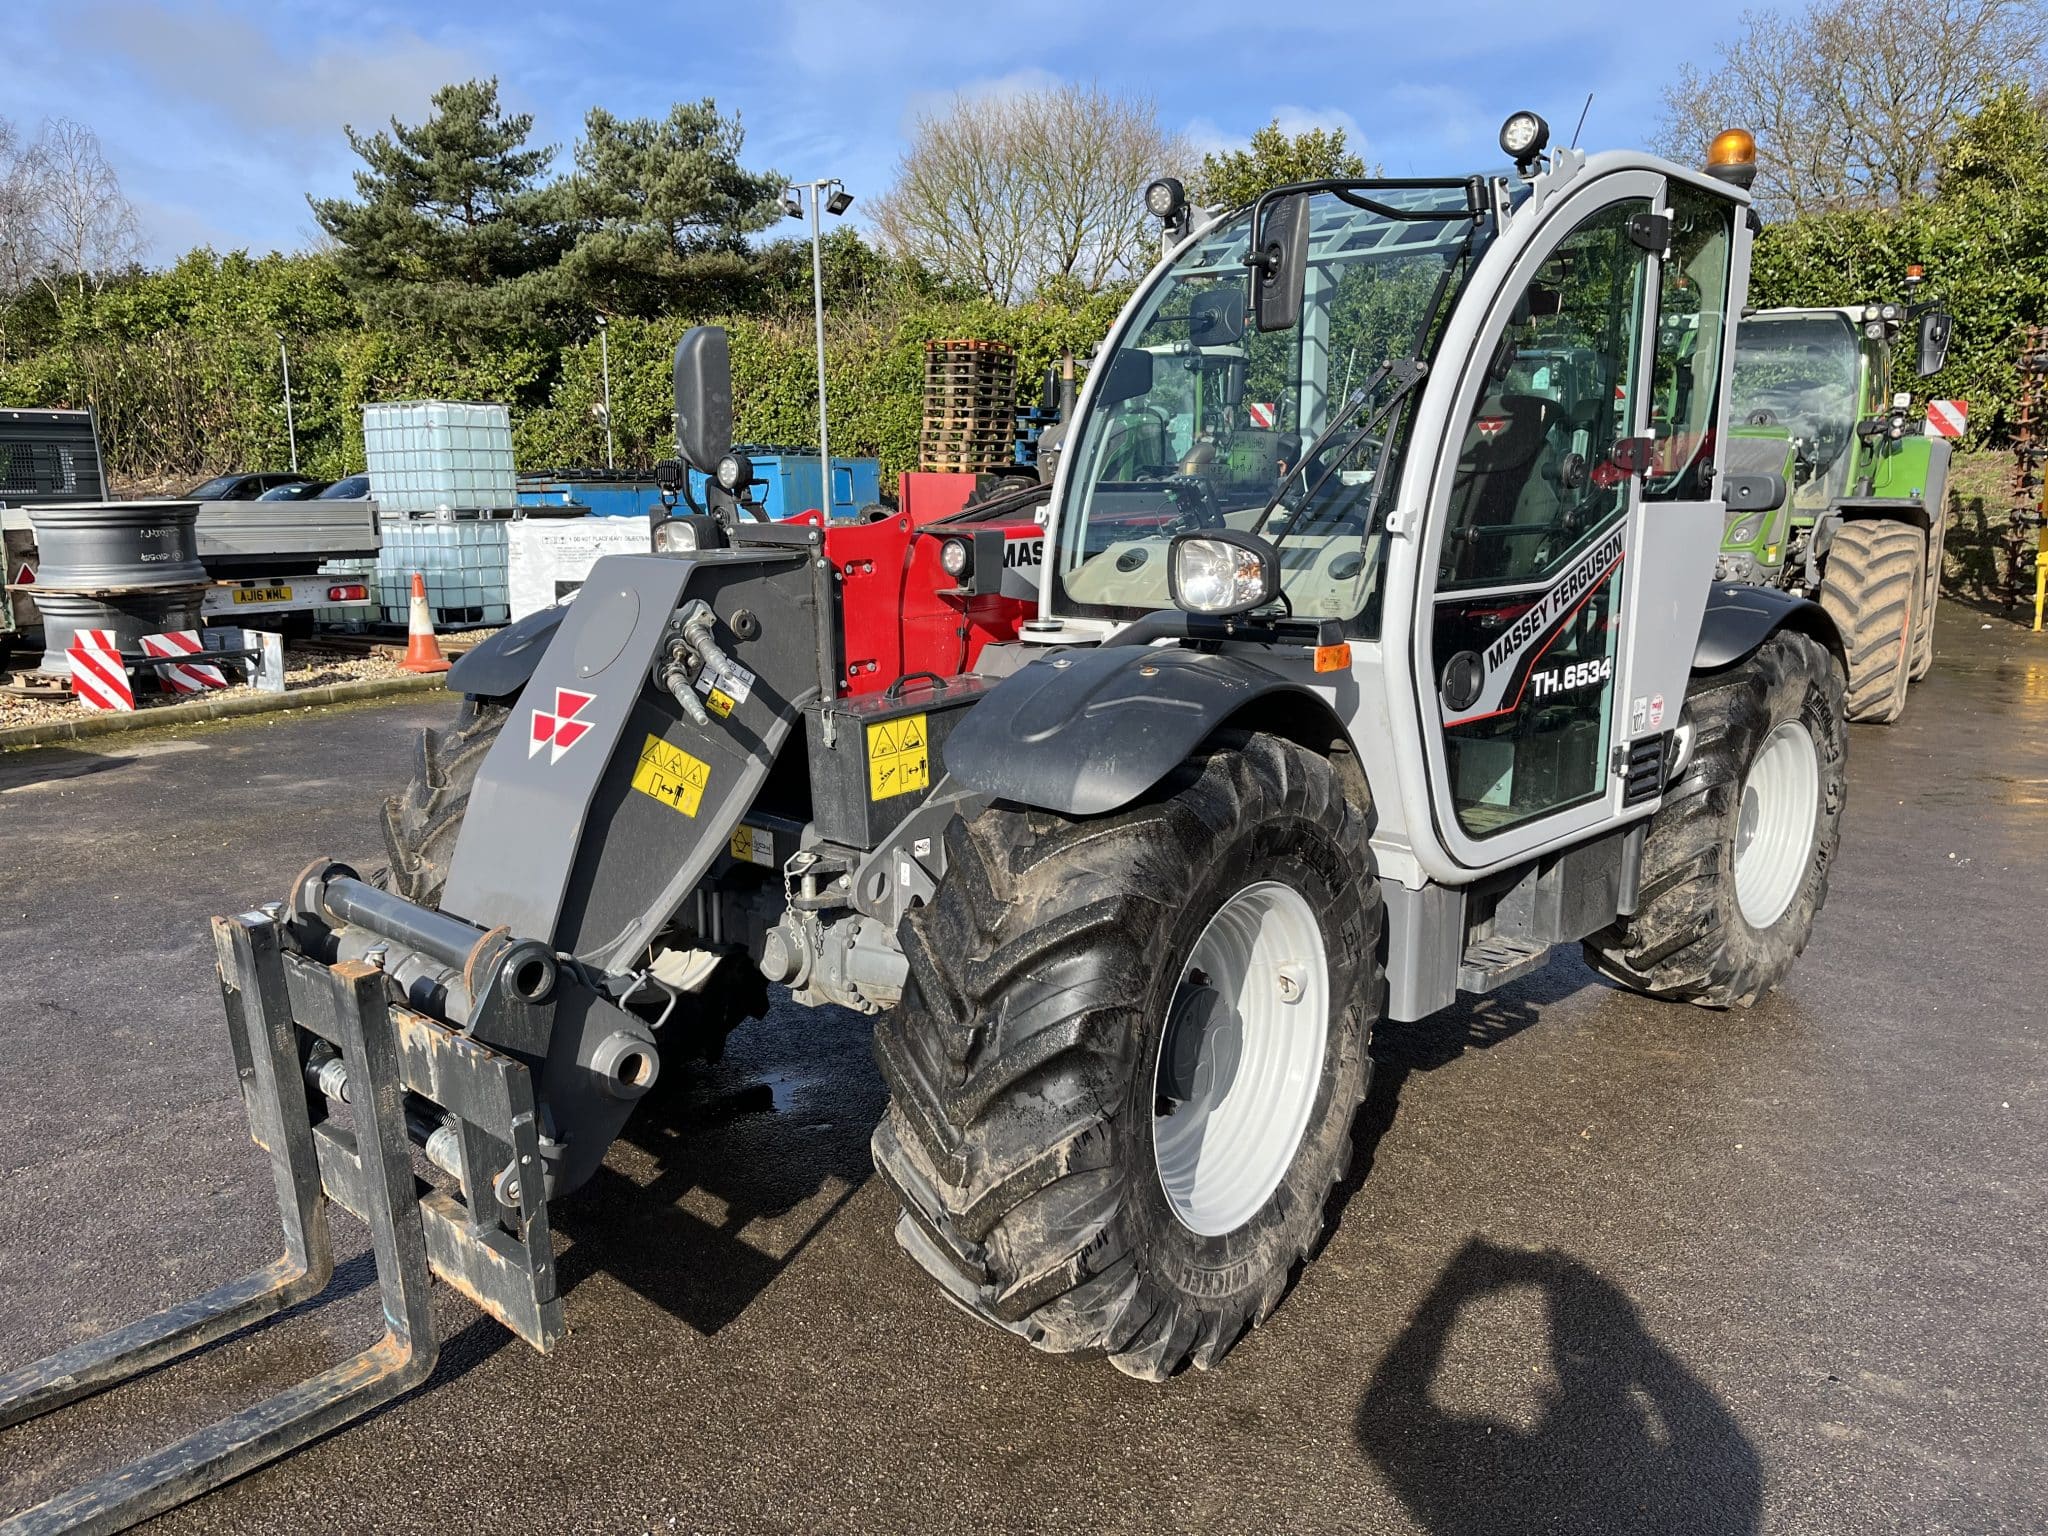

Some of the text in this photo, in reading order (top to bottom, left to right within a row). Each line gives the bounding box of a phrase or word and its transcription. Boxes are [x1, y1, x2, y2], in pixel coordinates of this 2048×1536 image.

[240, 590, 264, 602] AJ16
[1488, 532, 1622, 673] MASSEY FERGUSON
[1532, 657, 1611, 697] TH.6534
